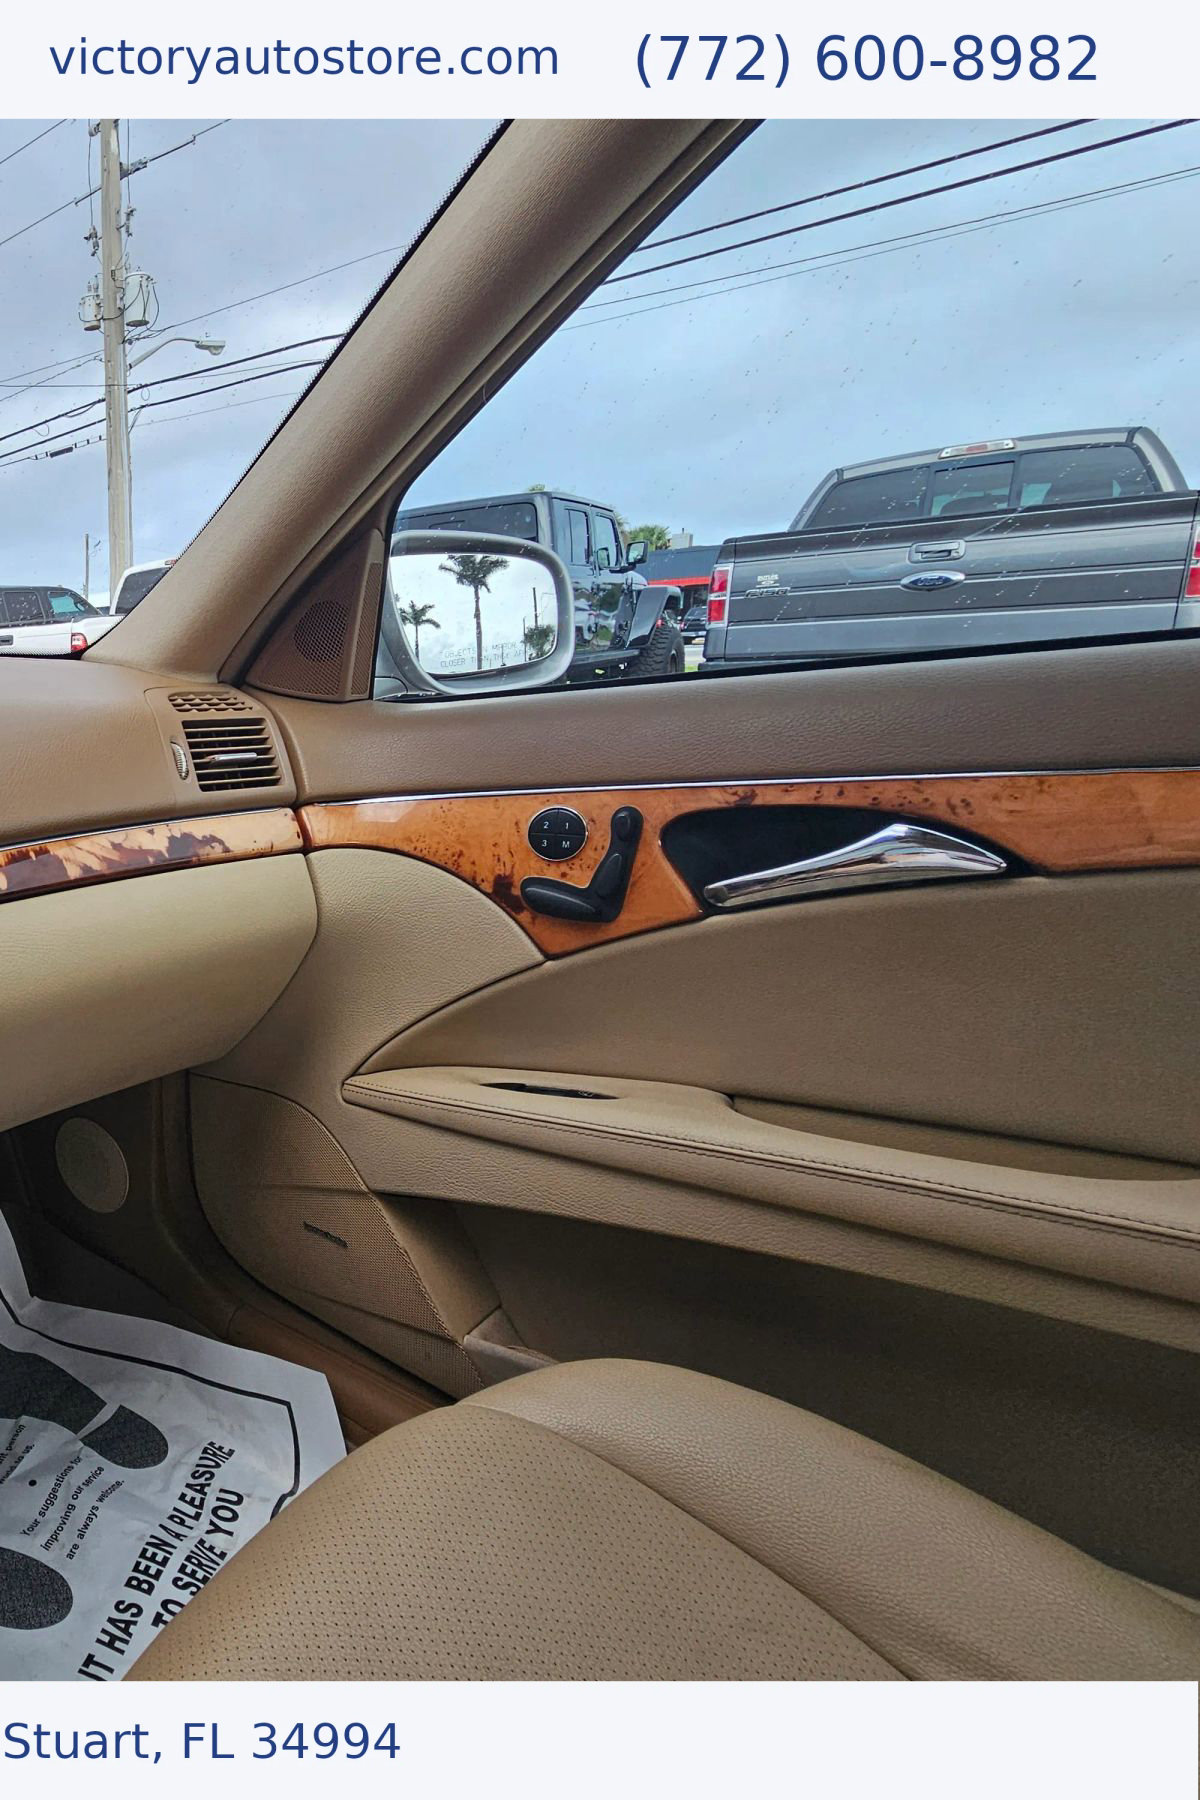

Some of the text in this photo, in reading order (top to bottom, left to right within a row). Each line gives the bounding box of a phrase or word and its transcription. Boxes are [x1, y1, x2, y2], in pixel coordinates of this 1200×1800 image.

[440, 658, 466, 668] CLOSER
[541, 839, 547, 847] 3
[543, 821, 549, 829] 2
[562, 840, 570, 848] M
[5, 1423, 26, 1452] person
[20, 1455, 83, 1537] Your suggestions for
[40, 1466, 105, 1552] improving our service
[66, 1543, 80, 1561] are
[76, 1504, 100, 1540] always
[77, 1440, 236, 1681] IT HAS BEEN A PLEASURE
[151, 1488, 245, 1628] TO SERVE YOU
